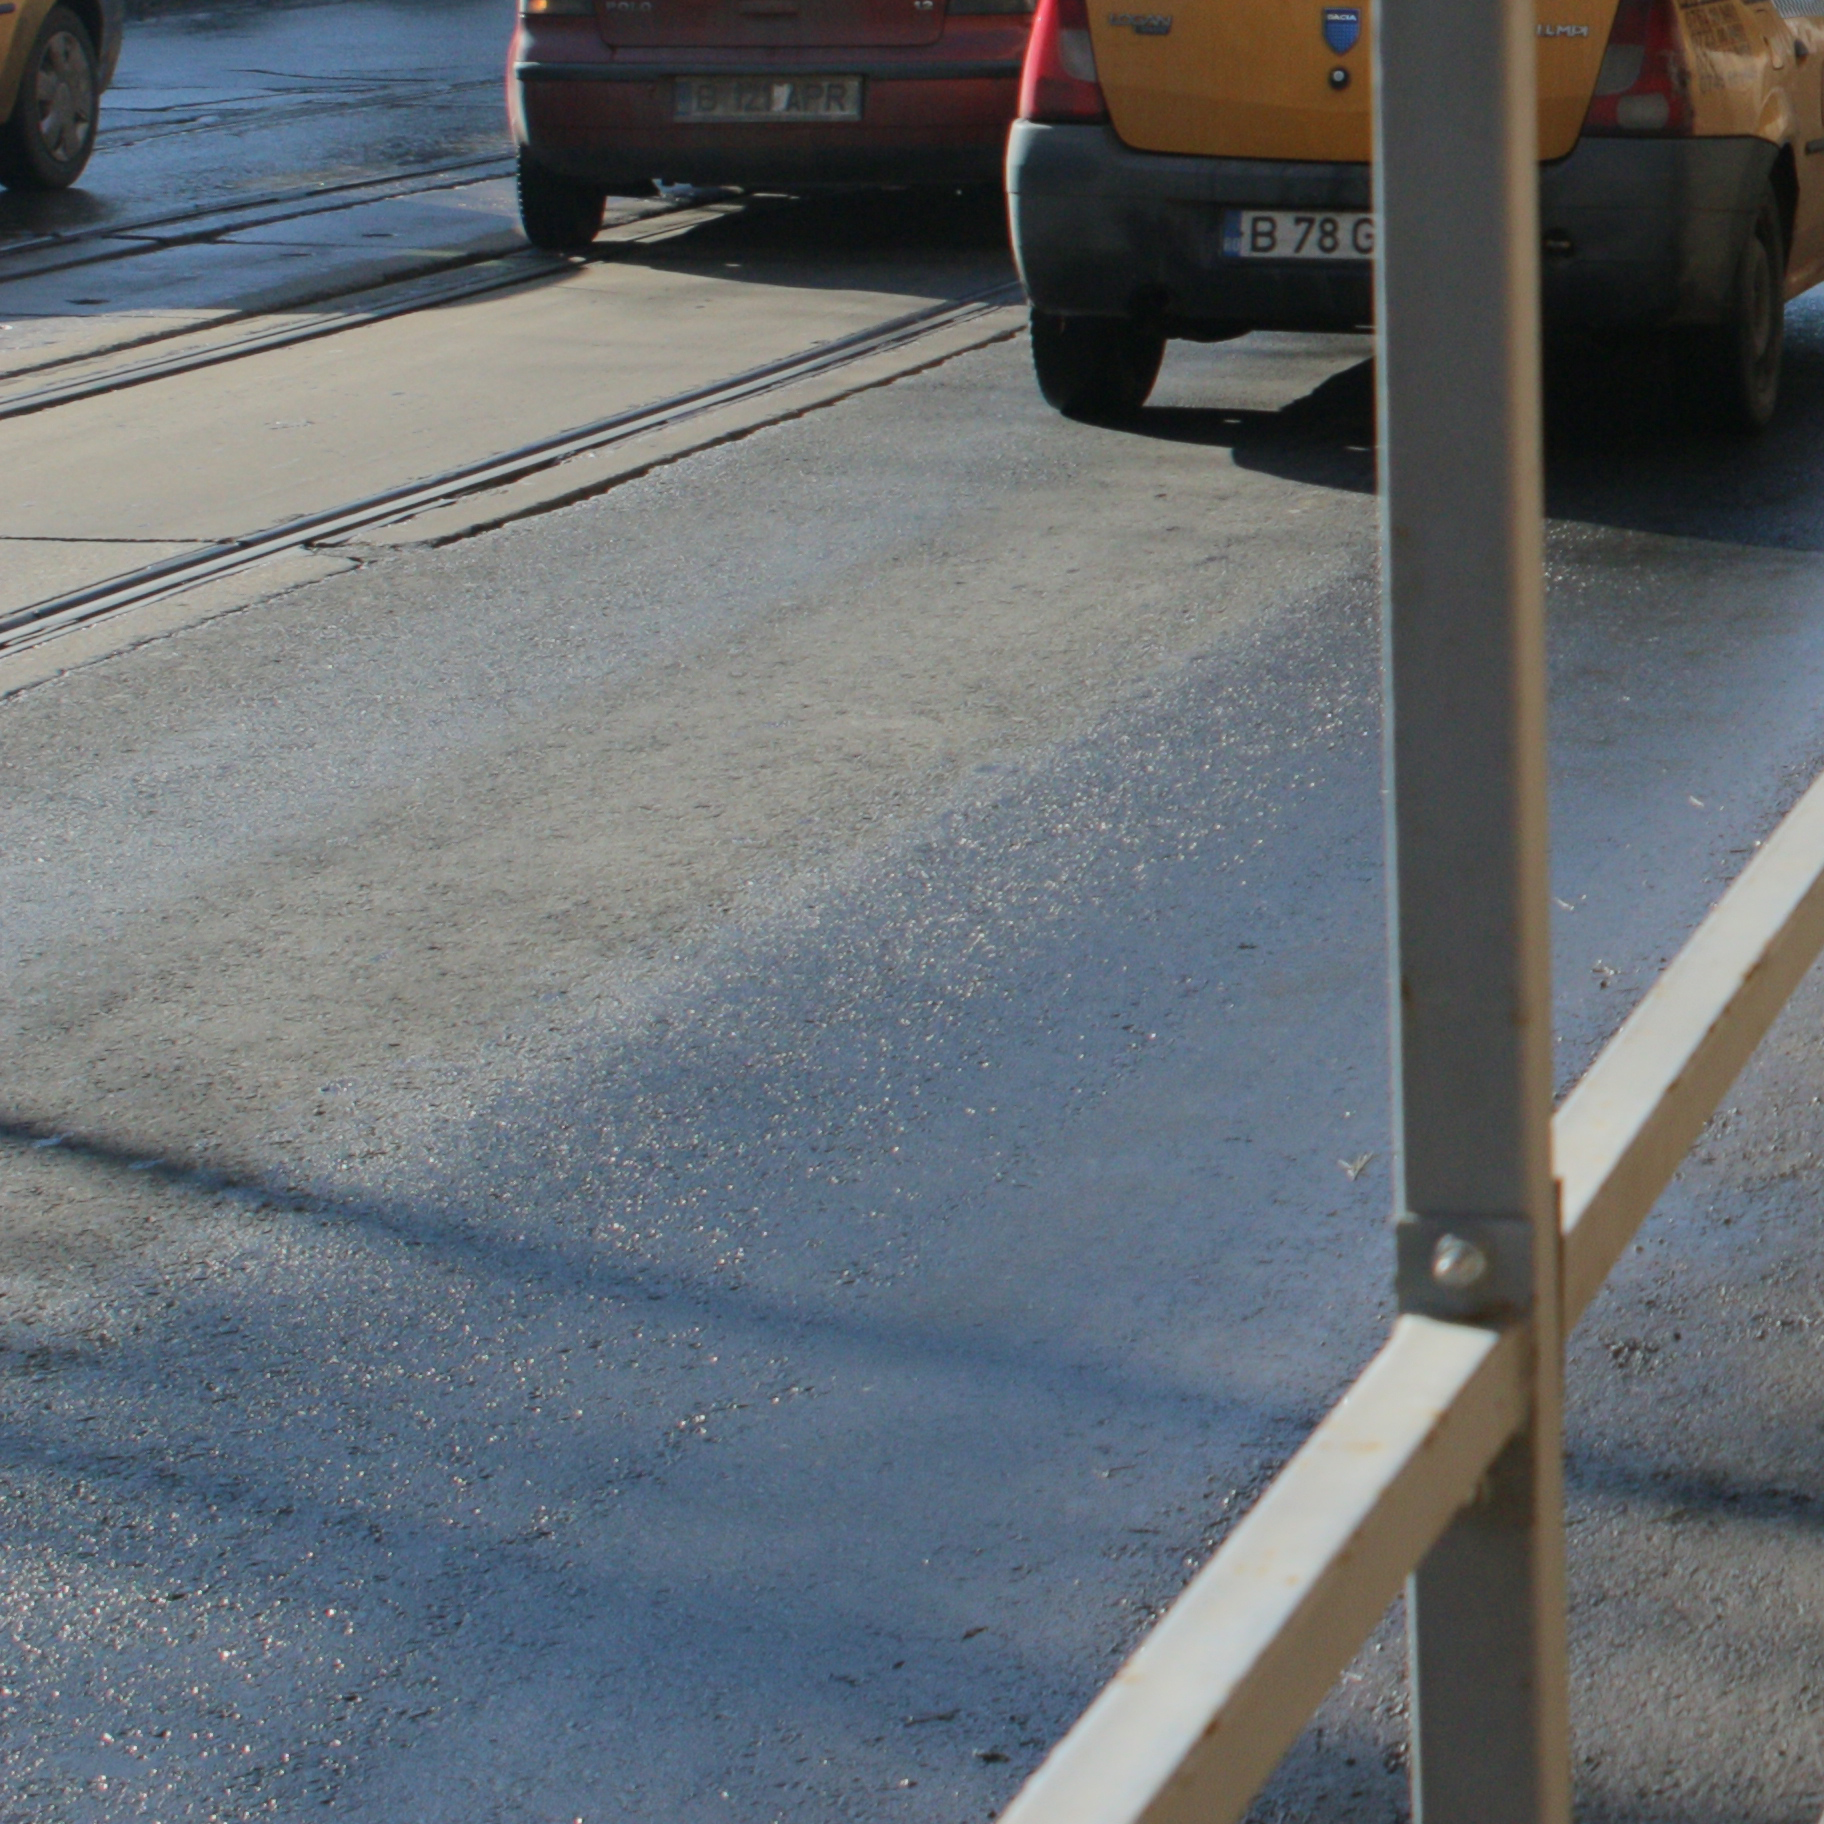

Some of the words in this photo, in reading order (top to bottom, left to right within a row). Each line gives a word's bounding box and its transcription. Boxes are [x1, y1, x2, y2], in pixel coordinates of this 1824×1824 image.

[1326, 13, 1357, 21] DACIA
[1251, 216, 1277, 253] B
[1293, 216, 1339, 254] 78
